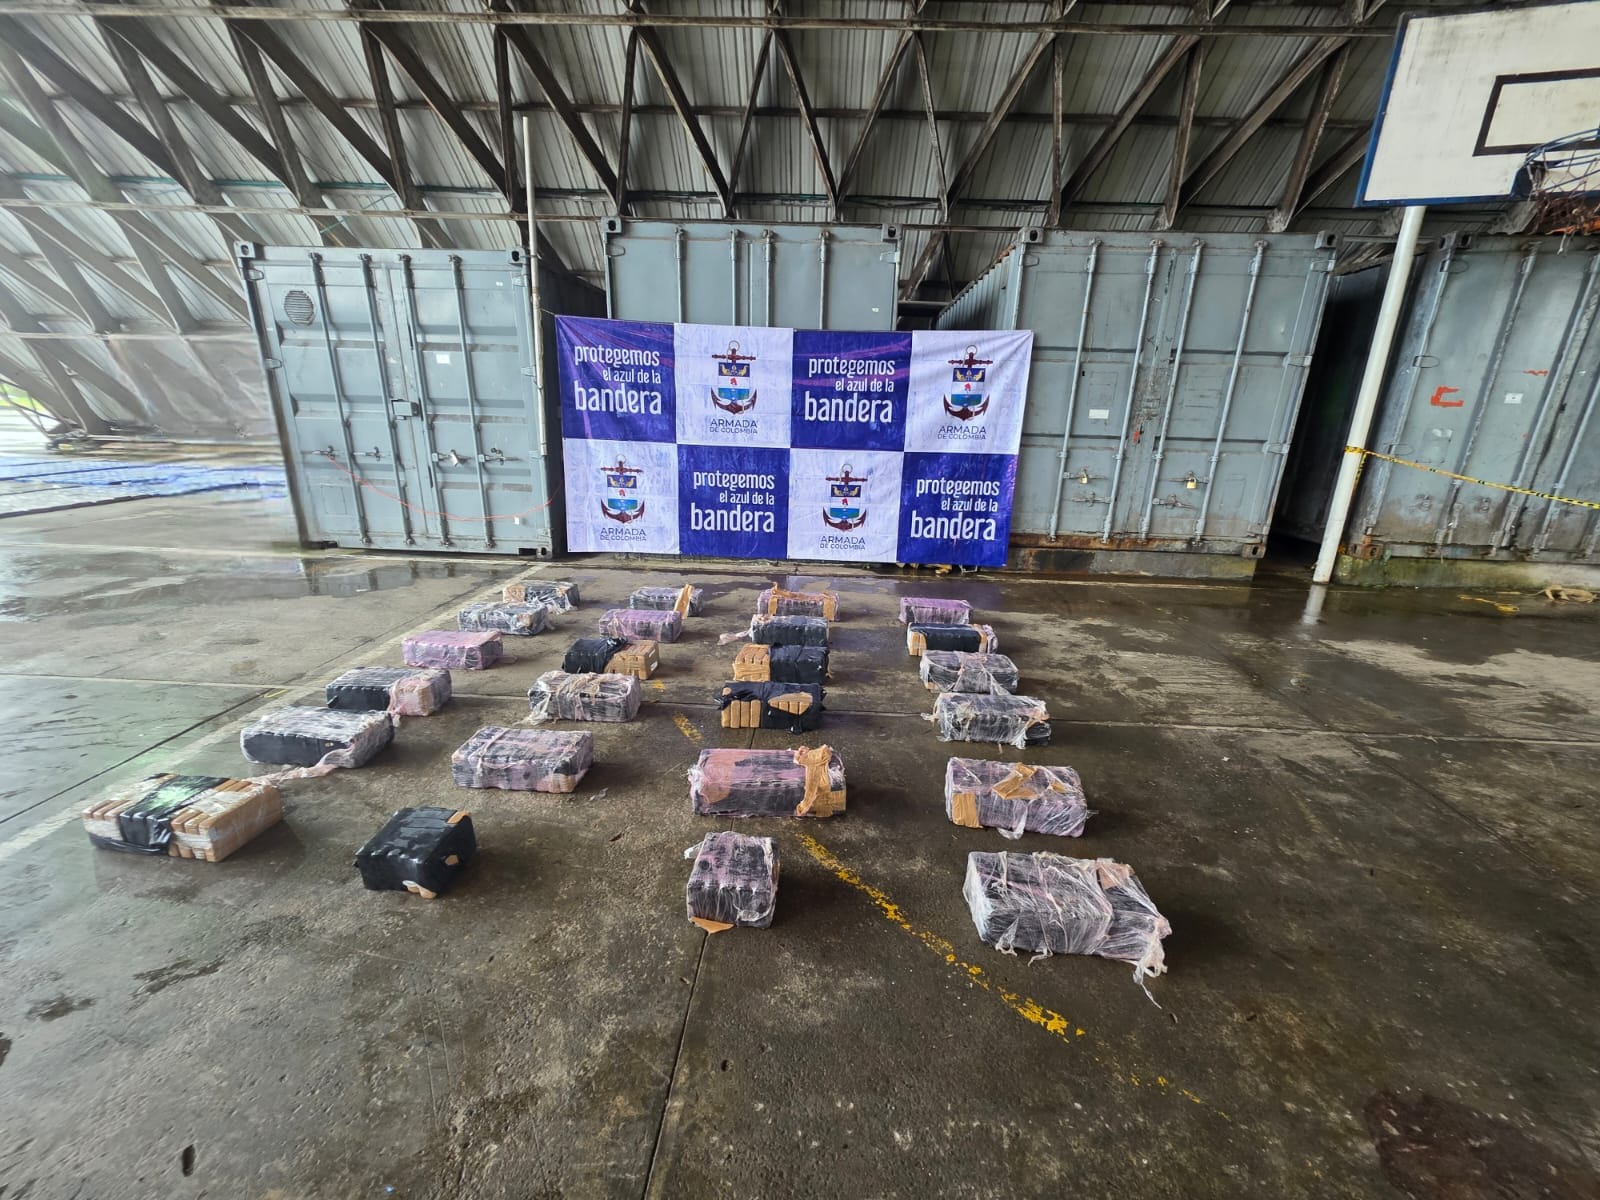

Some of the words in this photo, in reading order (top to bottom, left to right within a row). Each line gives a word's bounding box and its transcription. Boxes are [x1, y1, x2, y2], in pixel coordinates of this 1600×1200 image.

[574, 345, 660, 368] protegemos
[602, 367, 611, 381] el
[613, 369, 635, 383] azul
[637, 369, 650, 384] de
[651, 369, 662, 384] la
[808, 356, 896, 378] protegemos
[835, 378, 845, 391] el
[846, 378, 868, 392] azul
[869, 378, 883, 392] de
[884, 378, 895, 393] la
[574, 380, 662, 415] bandera
[804, 390, 893, 423] bandera
[710, 418, 758, 428] ARMADA
[938, 425, 987, 435] ARMADA
[693, 470, 775, 491] protegemos
[915, 476, 1001, 498] protegemos
[719, 490, 728, 503] el
[729, 490, 750, 504] azul
[751, 492, 764, 505] de
[765, 491, 775, 505] la
[941, 497, 951, 511] el
[952, 498, 973, 511] azul
[974, 498, 987, 512] de
[988, 498, 999, 512] la
[690, 502, 775, 533] bandera
[910, 510, 997, 541] bandera
[600, 527, 647, 536] ARMADA
[820, 535, 866, 545] ARMADA
